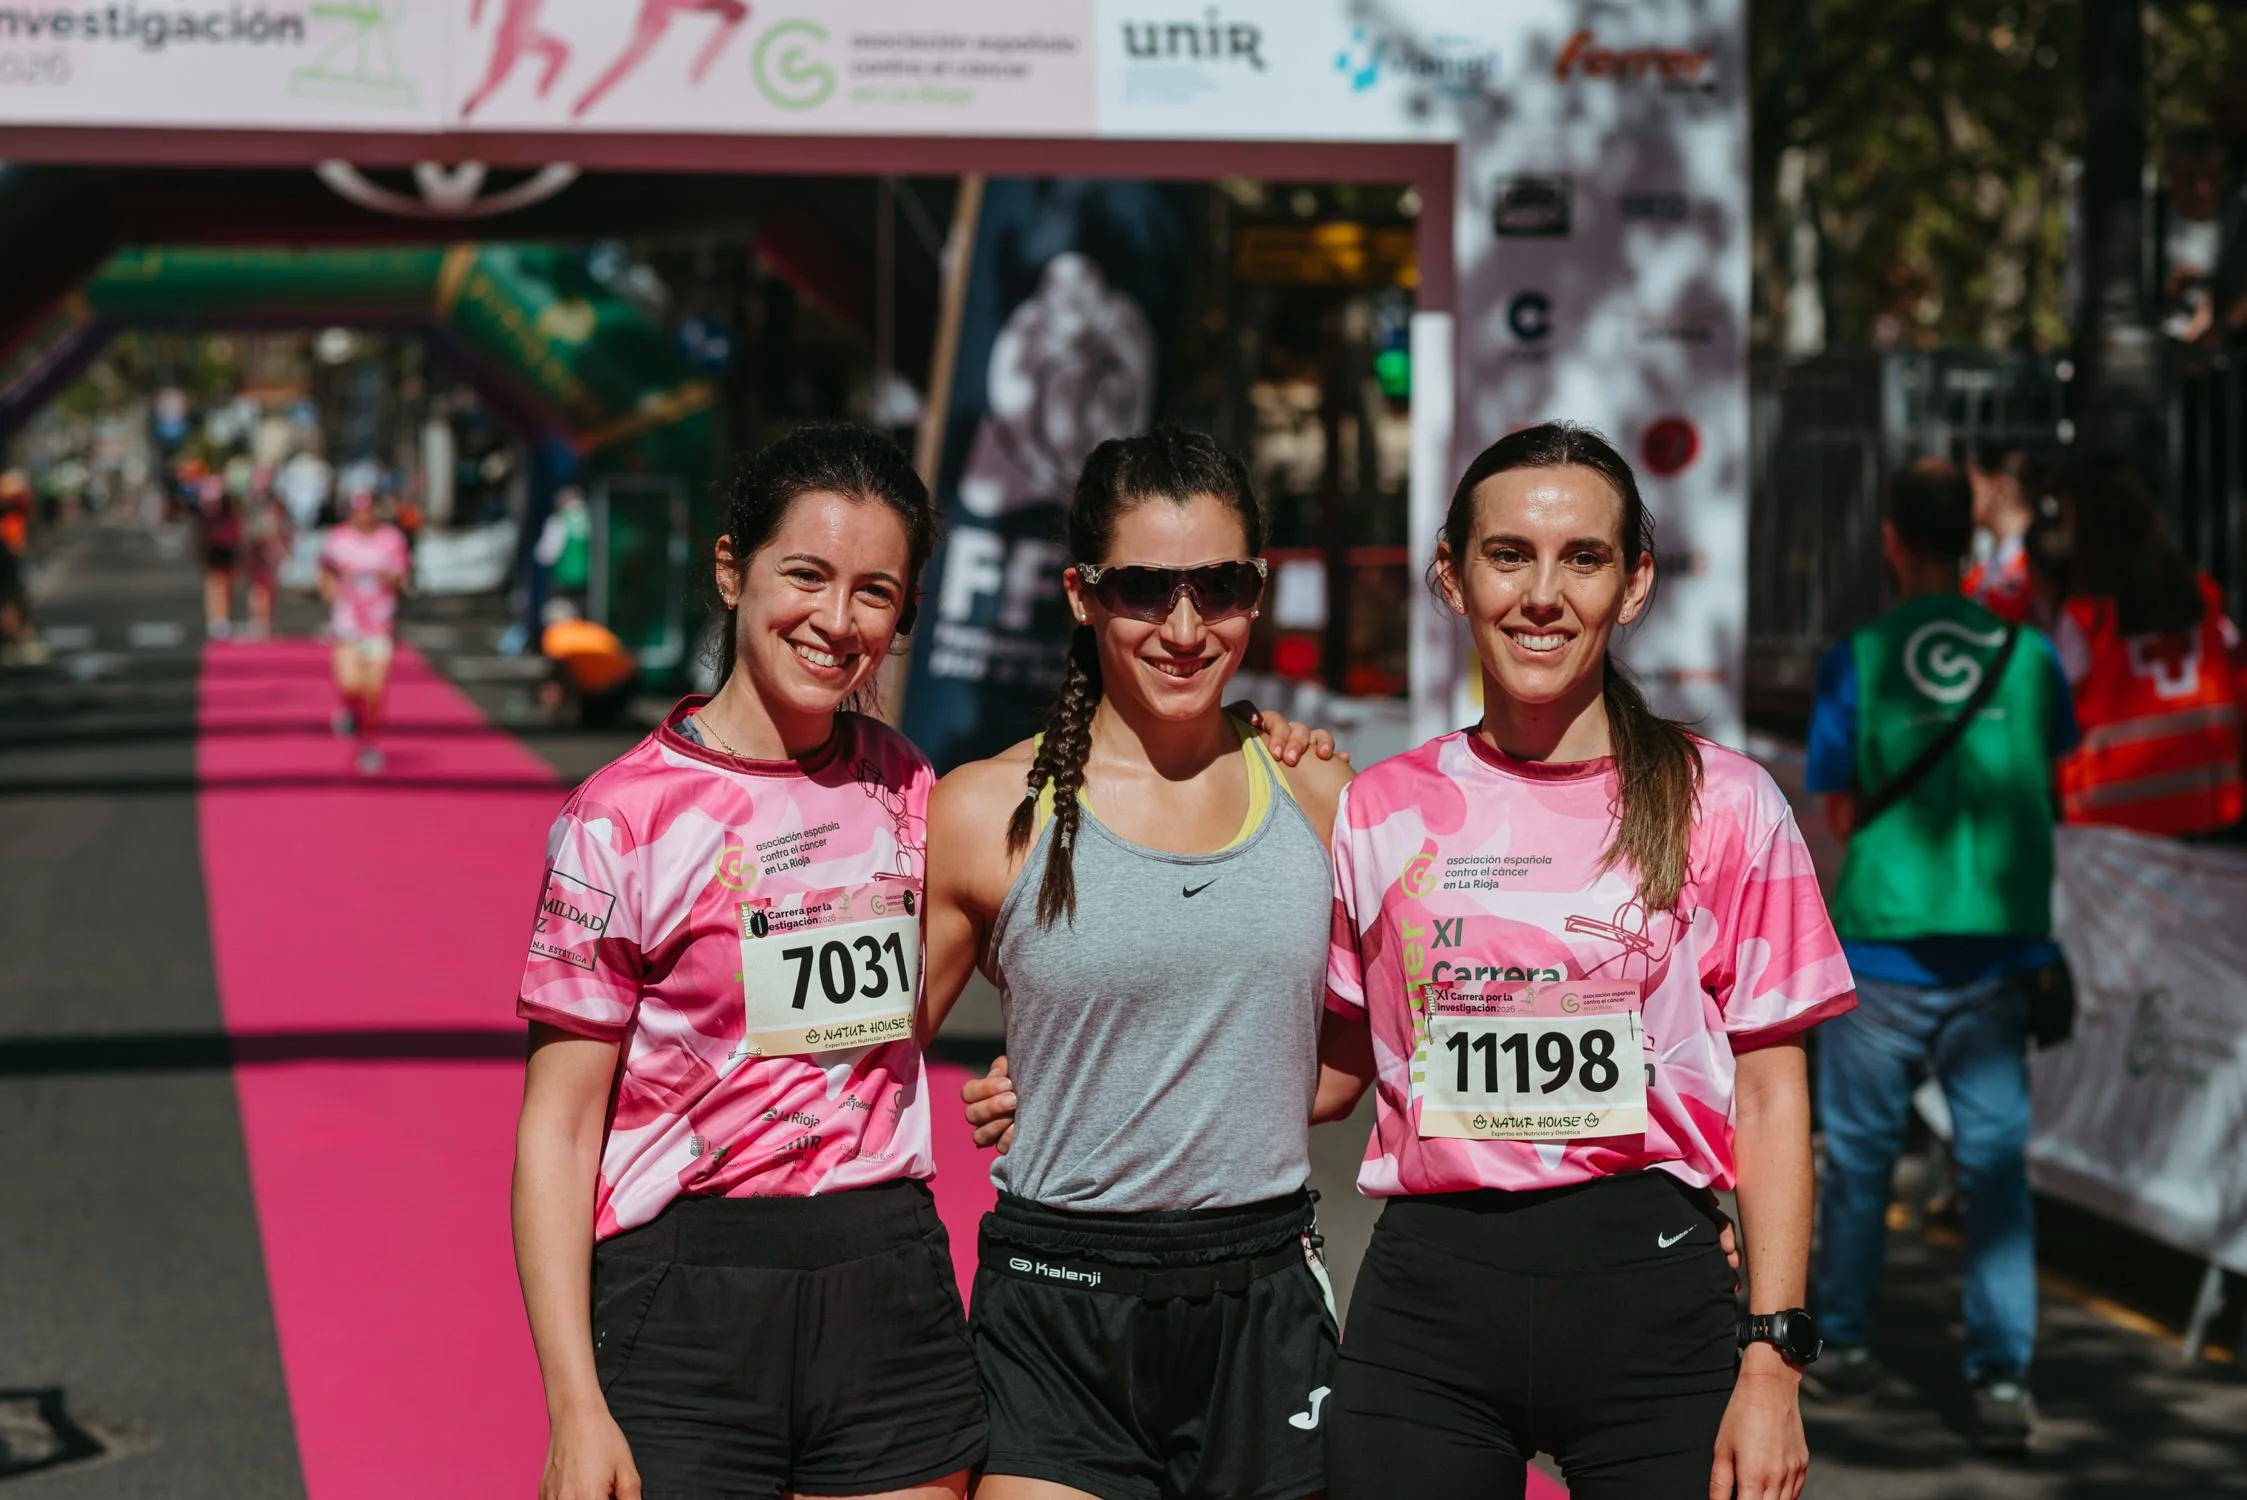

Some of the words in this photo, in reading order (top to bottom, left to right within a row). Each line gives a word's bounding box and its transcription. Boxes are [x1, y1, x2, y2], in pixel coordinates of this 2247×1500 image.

[756, 832, 802, 851] asociación
[803, 821, 840, 838] española
[760, 850, 789, 863] contra
[790, 844, 799, 855] el
[799, 838, 828, 852] cáncer
[1446, 854, 1501, 865] asociación
[1503, 855, 1552, 866] española
[765, 866, 777, 875] en
[777, 862, 789, 872] La
[789, 856, 811, 869] Rioja
[1445, 868, 1478, 877] contra
[1480, 867, 1490, 876] el
[1492, 867, 1528, 877] cáncer
[1443, 881, 1456, 889] en
[1458, 880, 1471, 889] La
[1473, 879, 1499, 890] Rioja
[768, 908, 804, 919] Carrera
[806, 905, 822, 916] por
[822, 903, 832, 911] la
[741, 905, 752, 937] mujer
[768, 916, 818, 931] estigación
[818, 914, 837, 923] 2026
[1431, 917, 1463, 950] XI
[548, 945, 588, 964] ESTÉTICA
[782, 932, 910, 1010] 7031
[1432, 960, 1560, 982] Carrera
[1435, 989, 1448, 1000] XI
[1450, 992, 1484, 1001] Carrera
[1486, 994, 1502, 1004] por
[1503, 992, 1513, 1001] la
[1437, 1003, 1496, 1014] Investigación
[1496, 1005, 1516, 1013] 2026
[823, 1024, 867, 1041] NATUR
[870, 1018, 905, 1033] HOUSE
[825, 1041, 849, 1049] Expertos
[1445, 1029, 1619, 1095] 11198
[1490, 1116, 1534, 1129] NATUR
[1537, 1116, 1581, 1128] HOUSE
[1035, 1262, 1101, 1287] Kalenji
